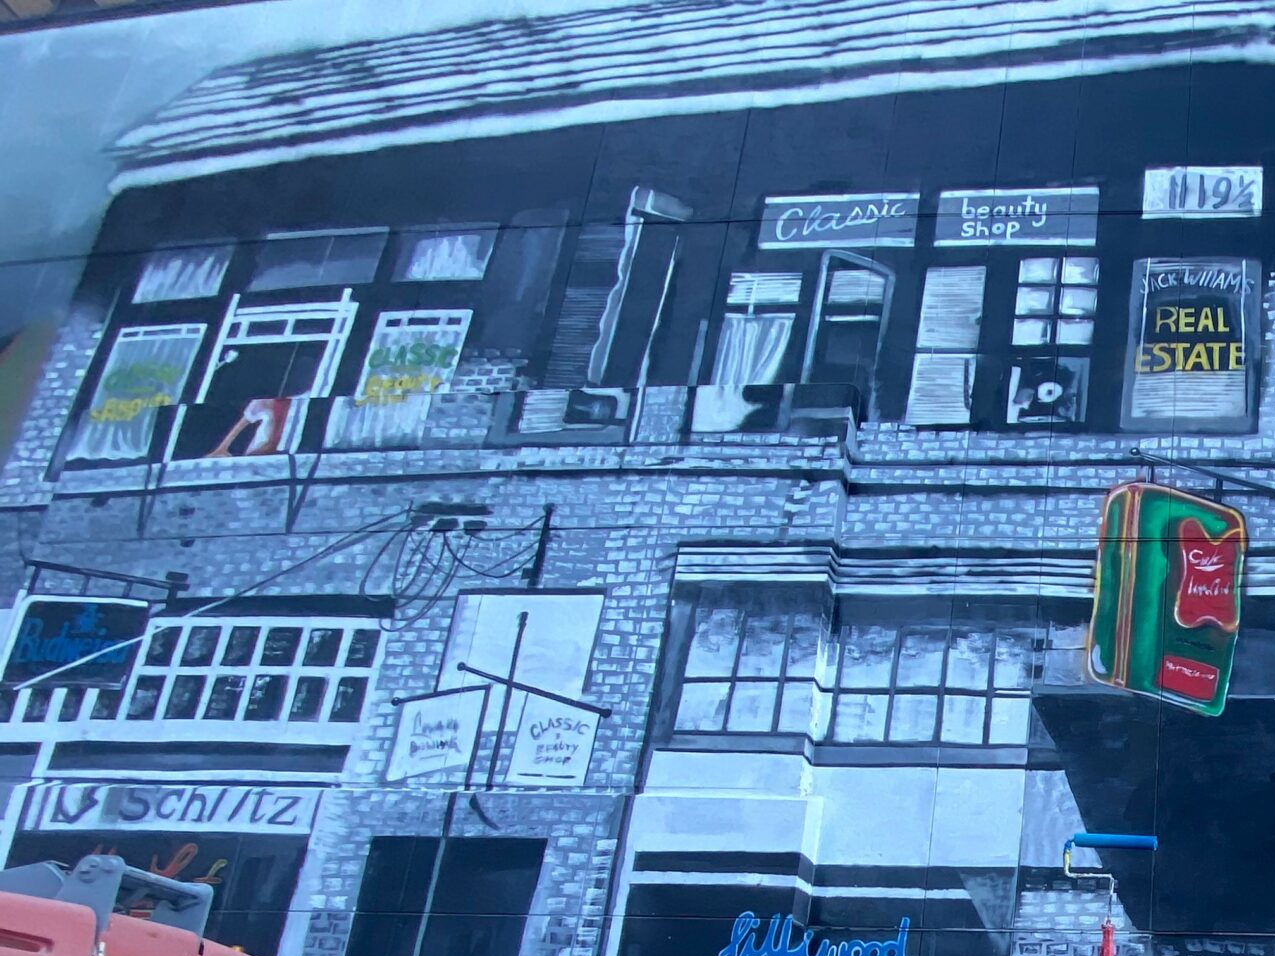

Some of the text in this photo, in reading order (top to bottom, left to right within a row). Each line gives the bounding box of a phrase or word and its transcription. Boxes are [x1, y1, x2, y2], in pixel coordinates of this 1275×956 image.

[775, 199, 906, 241] Classic
[960, 195, 1048, 228] beauty
[1154, 306, 1230, 334] REAL
[1134, 342, 1246, 373] ESTATE
[530, 717, 590, 741] CLASSIC
